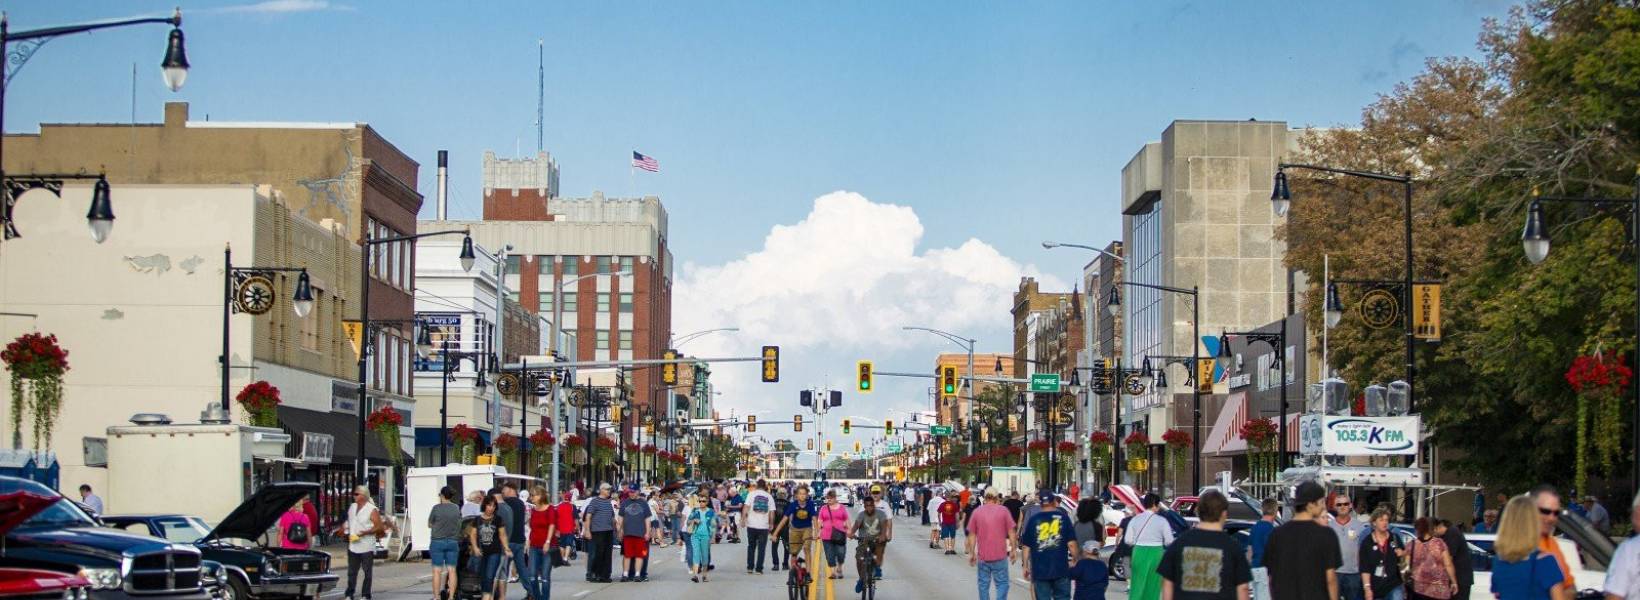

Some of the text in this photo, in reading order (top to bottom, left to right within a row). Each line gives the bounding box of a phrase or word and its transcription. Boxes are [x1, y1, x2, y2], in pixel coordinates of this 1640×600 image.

[1422, 286, 1431, 322] GATHER
[1336, 430, 1367, 441] 105.3
[1039, 518, 1060, 541] 24
